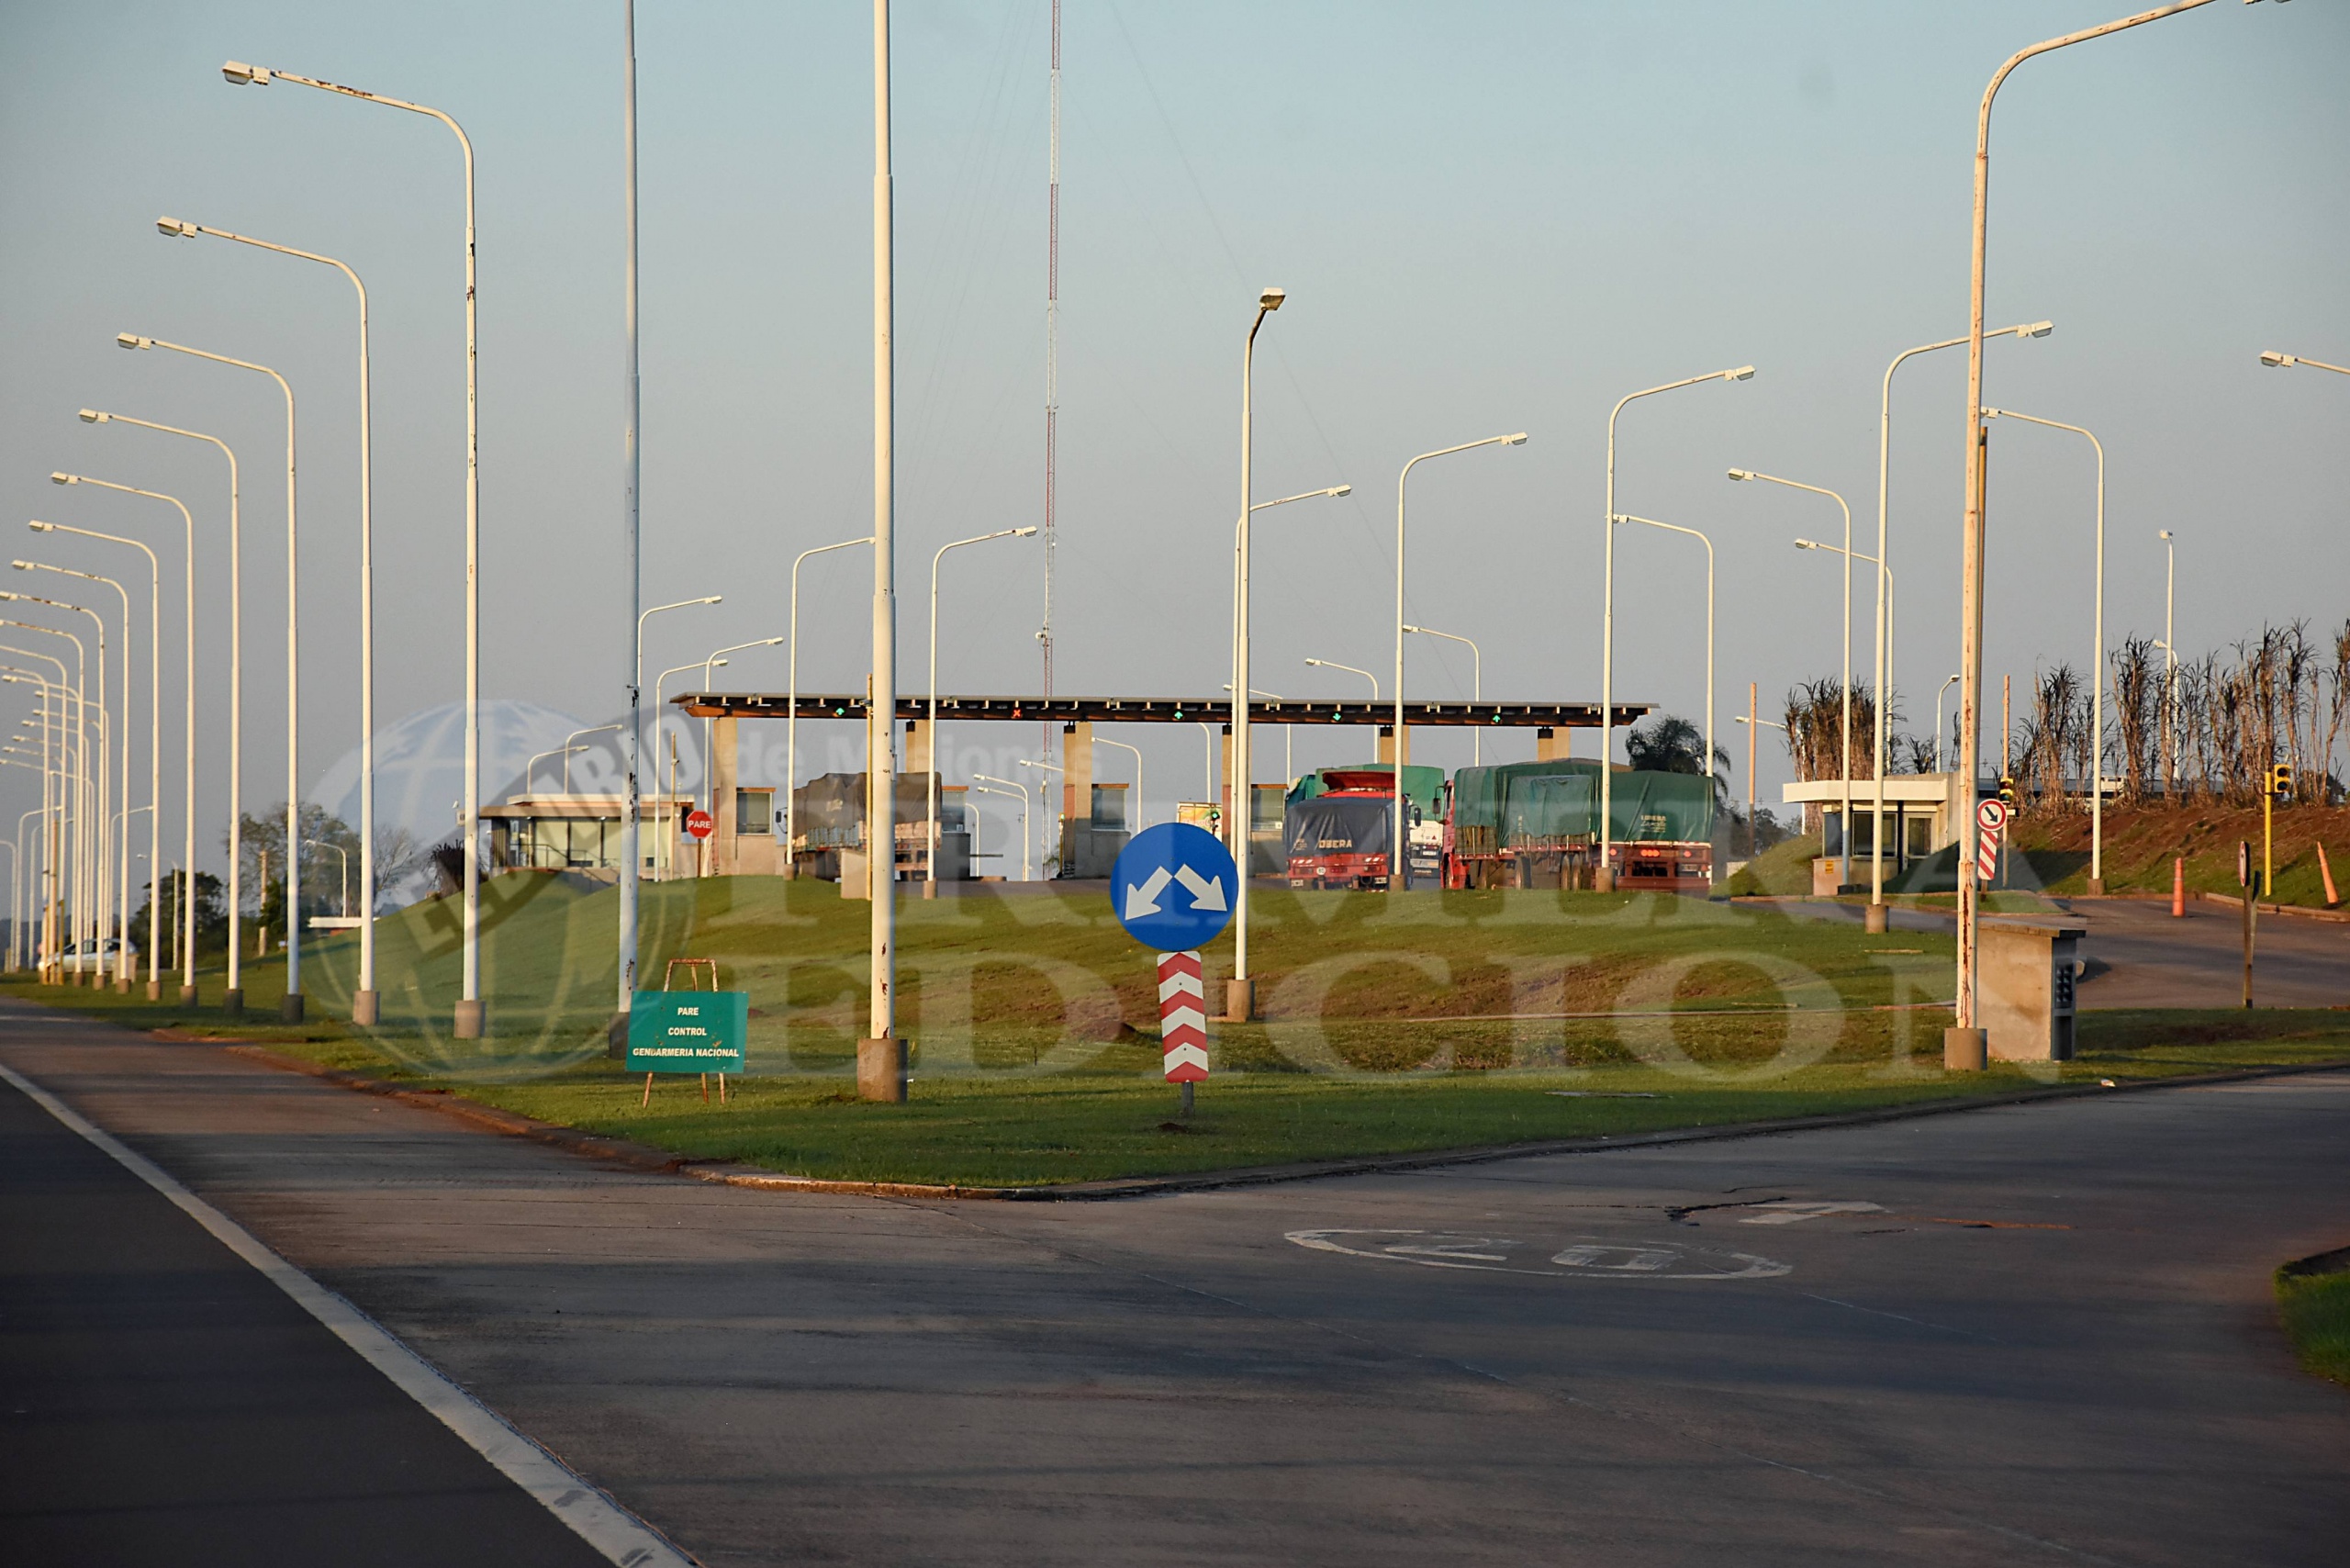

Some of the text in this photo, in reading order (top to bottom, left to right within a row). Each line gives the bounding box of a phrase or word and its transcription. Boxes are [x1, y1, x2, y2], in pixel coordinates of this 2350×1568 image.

[688, 820, 711, 829] PARE
[677, 1007, 699, 1015] PARE
[667, 1027, 708, 1036] CONTROL
[632, 1047, 739, 1058] GENDARMERIA NACIONAL
